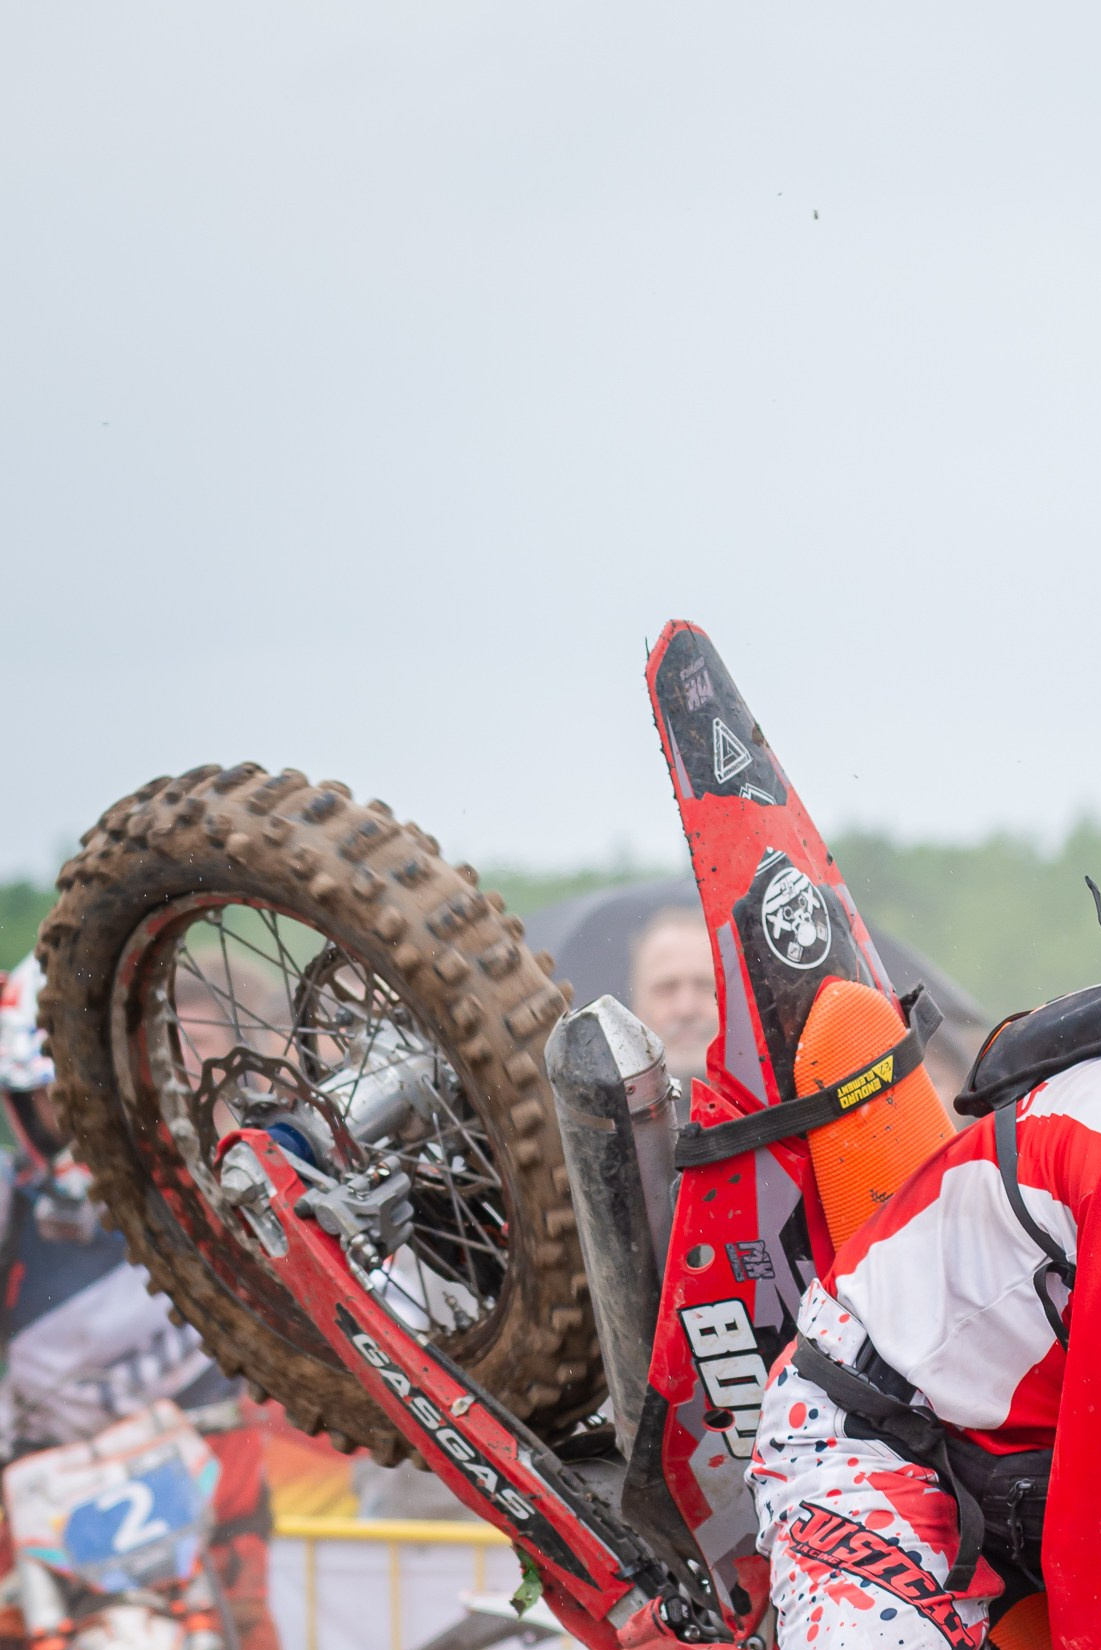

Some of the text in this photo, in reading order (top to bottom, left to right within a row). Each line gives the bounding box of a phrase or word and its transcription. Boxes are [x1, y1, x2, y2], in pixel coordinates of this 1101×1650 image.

[837, 1069, 876, 1098] ELEMENT
[839, 1078, 882, 1109] ENDURO
[352, 1333, 536, 1520] GASGAS
[96, 1480, 169, 1552] 2
